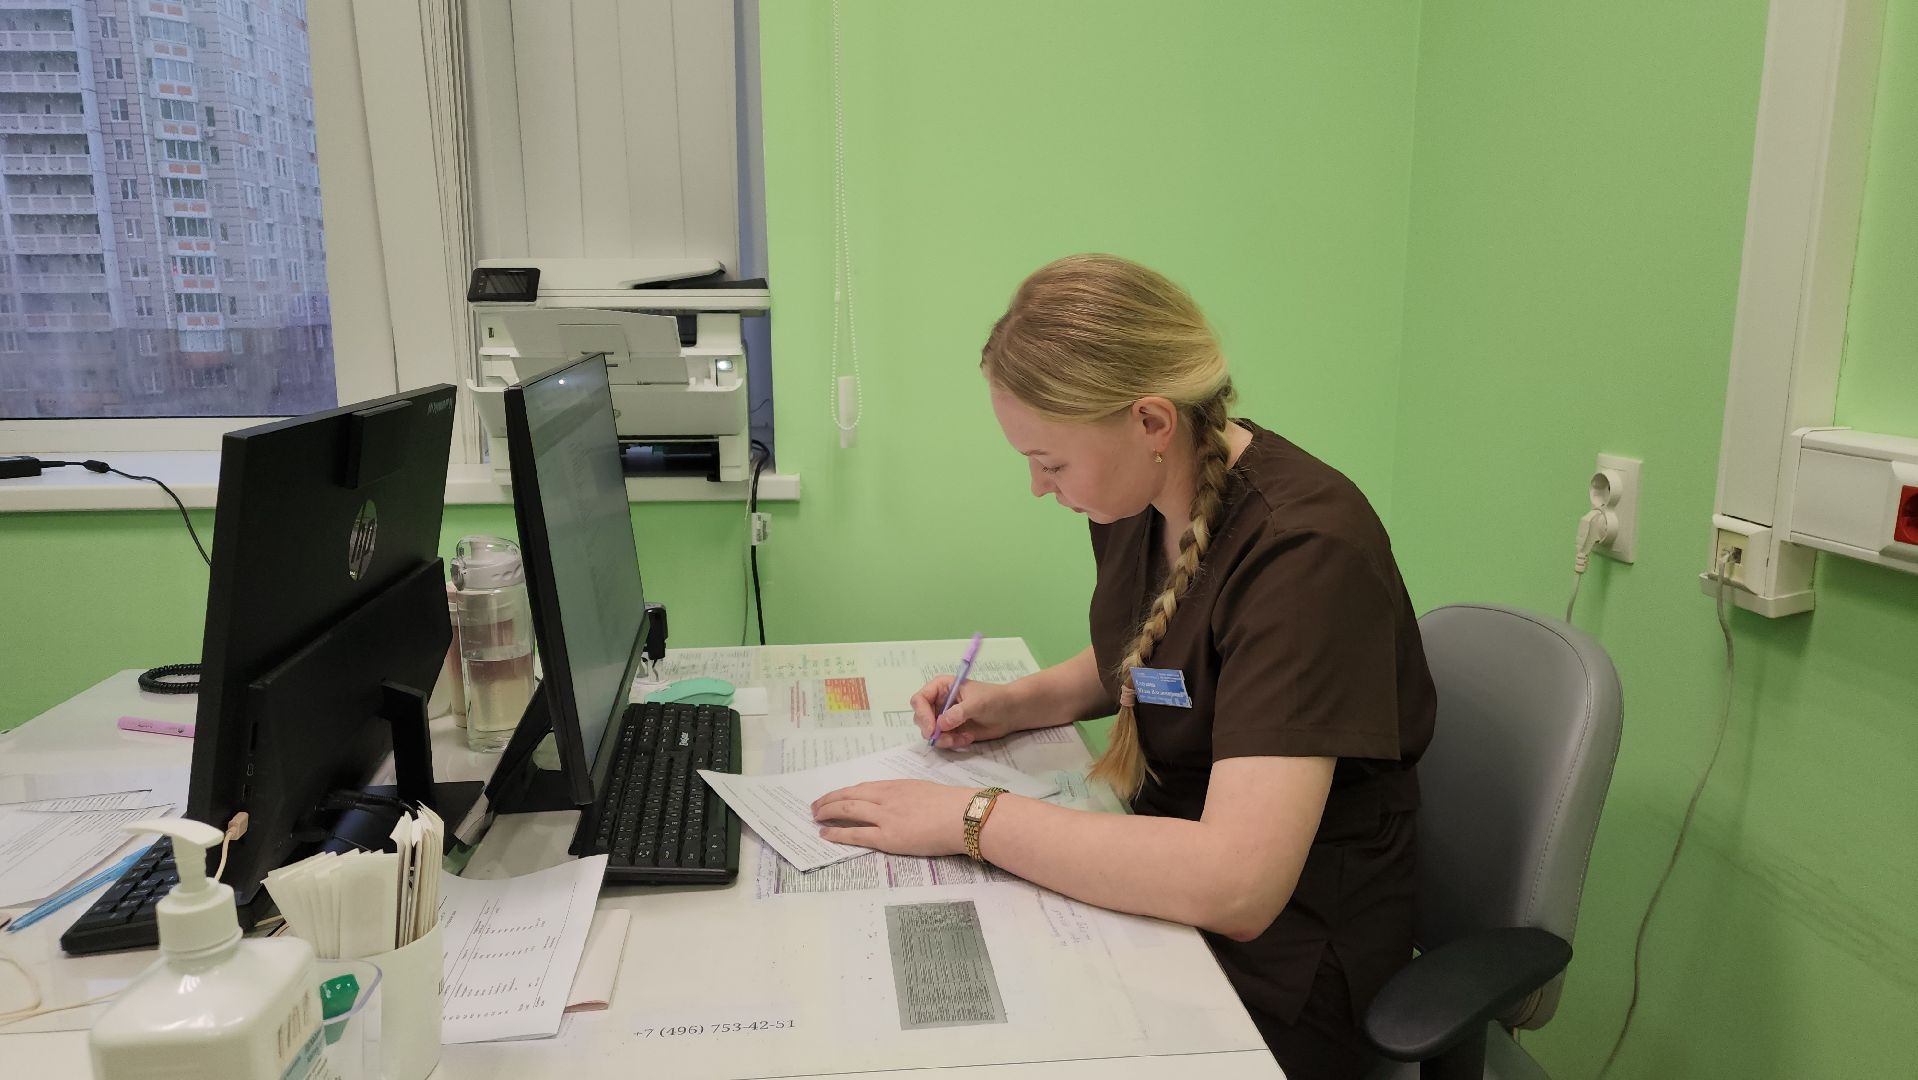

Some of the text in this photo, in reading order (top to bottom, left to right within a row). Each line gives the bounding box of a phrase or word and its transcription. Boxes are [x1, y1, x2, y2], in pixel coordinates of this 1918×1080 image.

[349, 500, 377, 580] hp
[633, 1019, 796, 1039] +7 (496) 753-42-51
